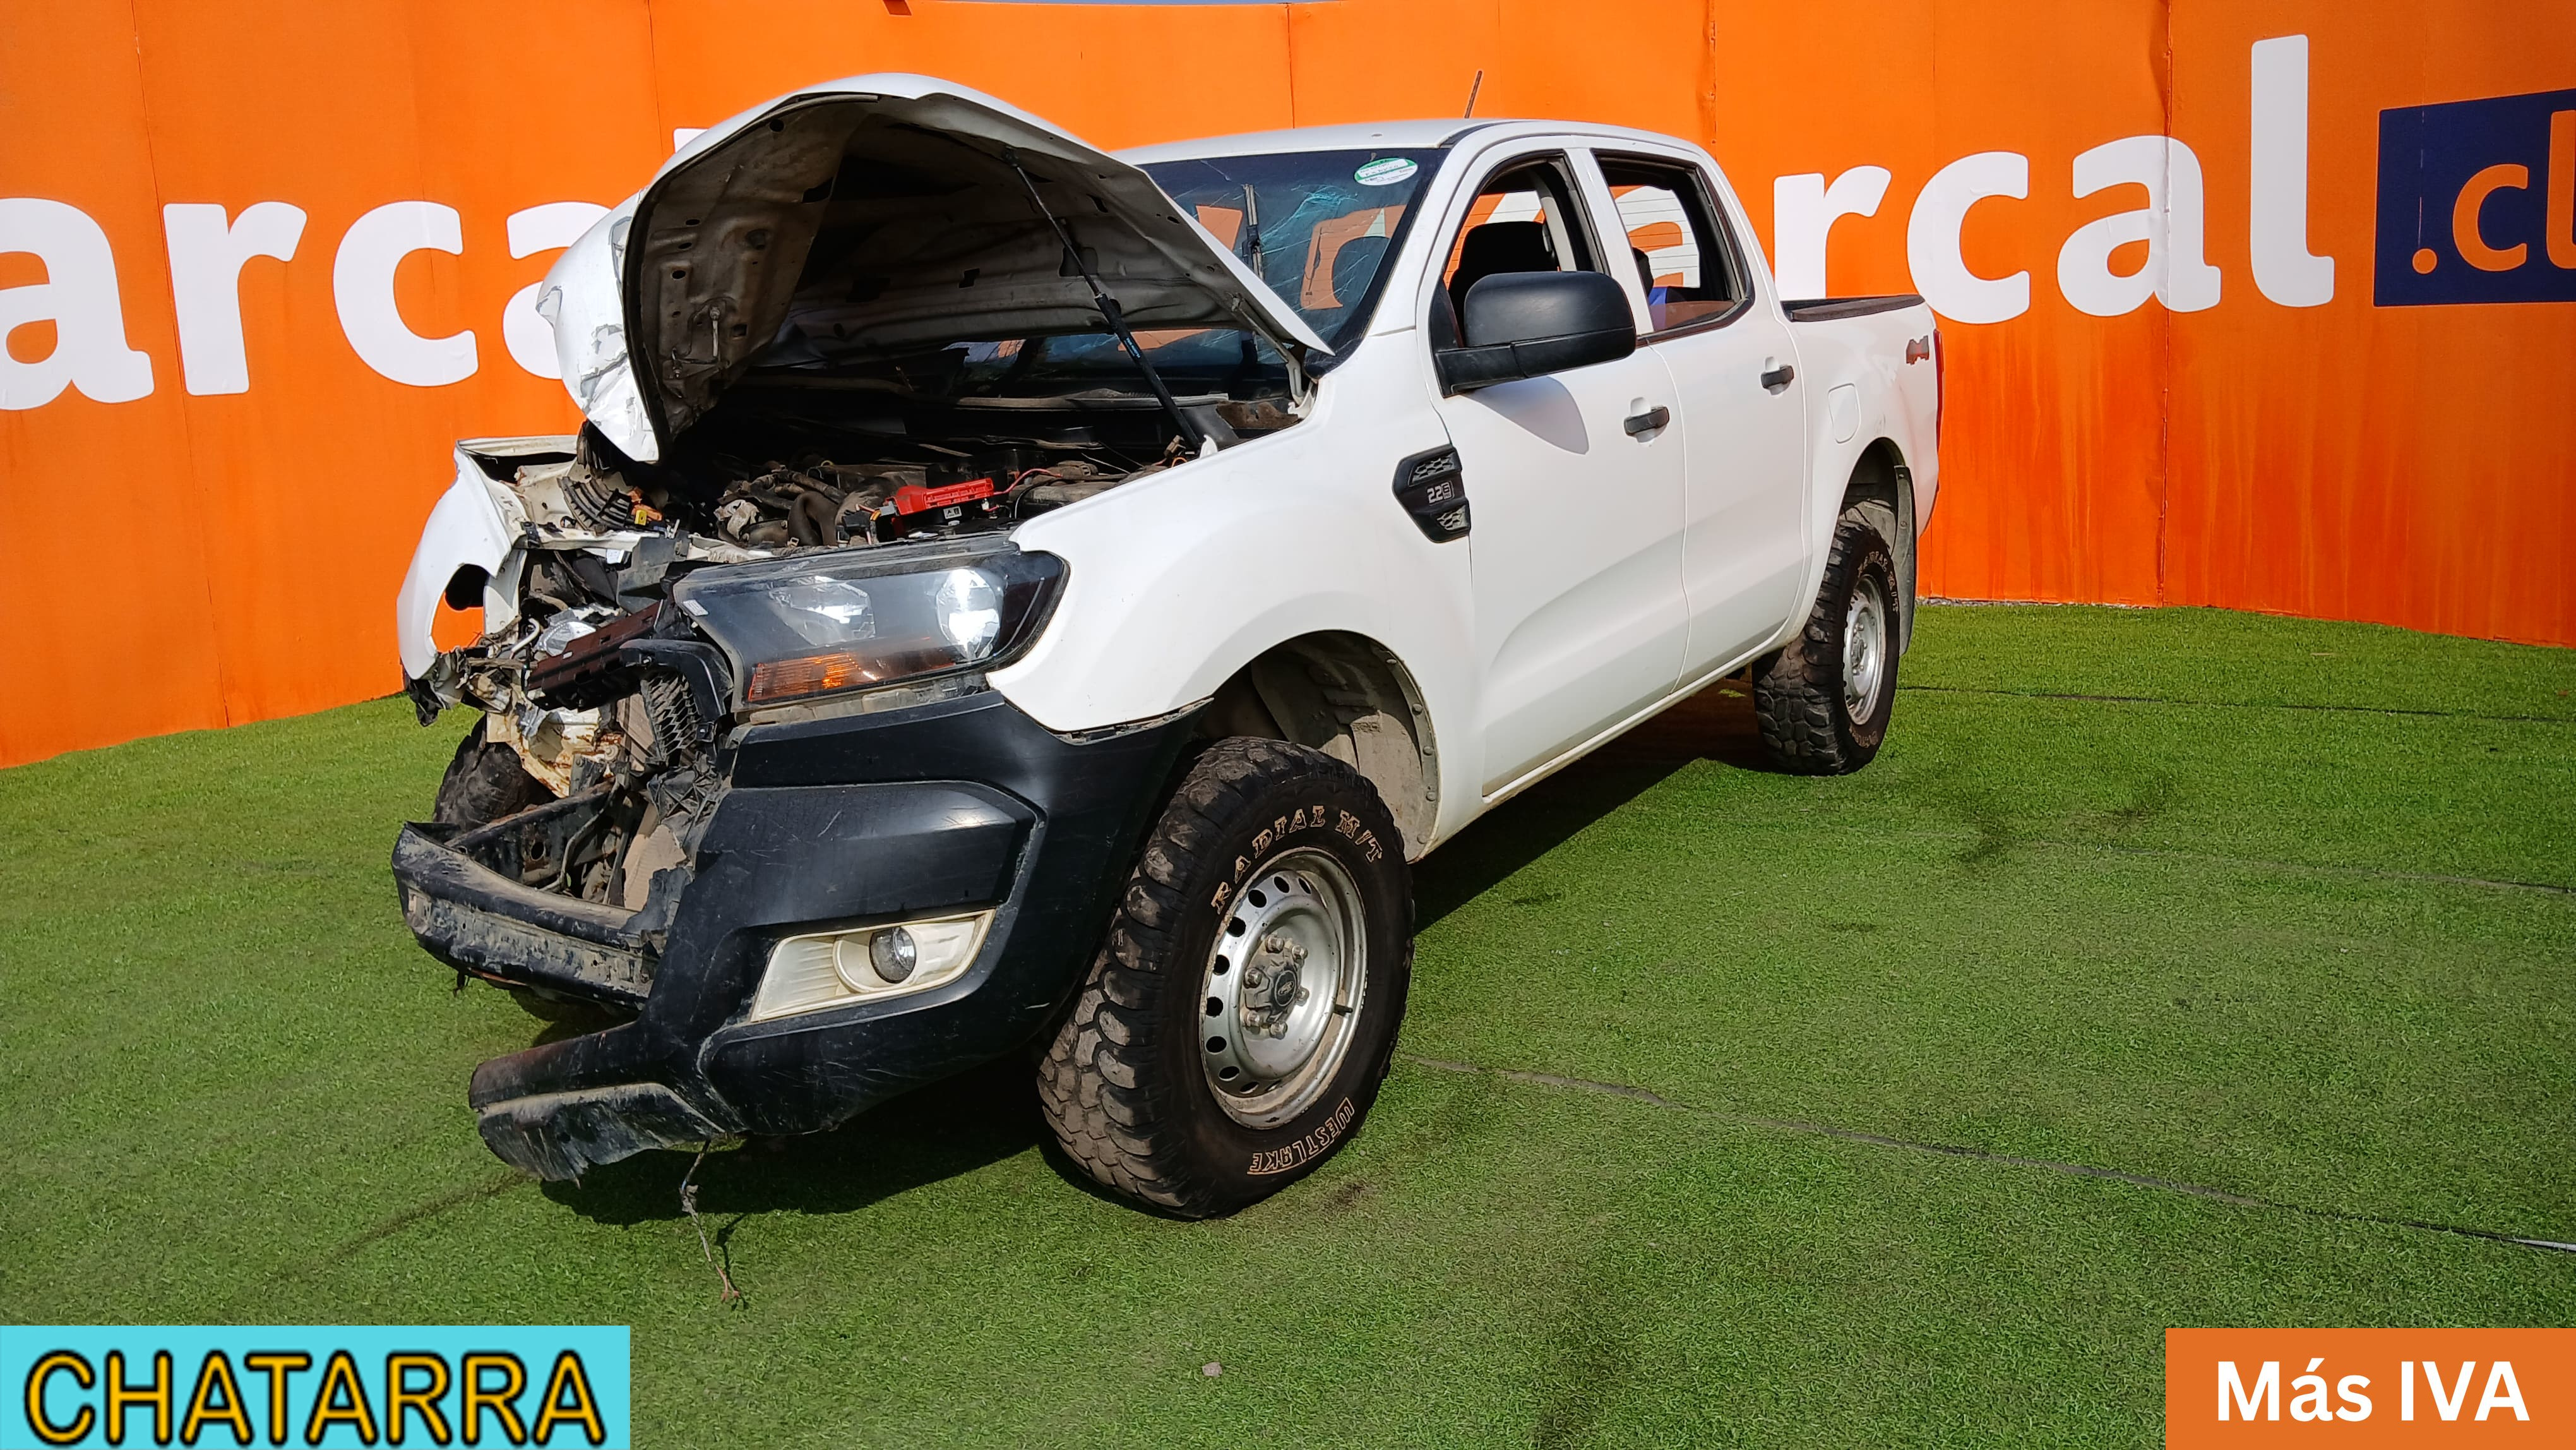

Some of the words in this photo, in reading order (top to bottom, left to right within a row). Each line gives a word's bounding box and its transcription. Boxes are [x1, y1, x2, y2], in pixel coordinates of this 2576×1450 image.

[0, 128, 707, 410] arca
[1210, 805, 1327, 915] RADIAL
[1248, 1096, 1355, 1173] WESTLAKE
